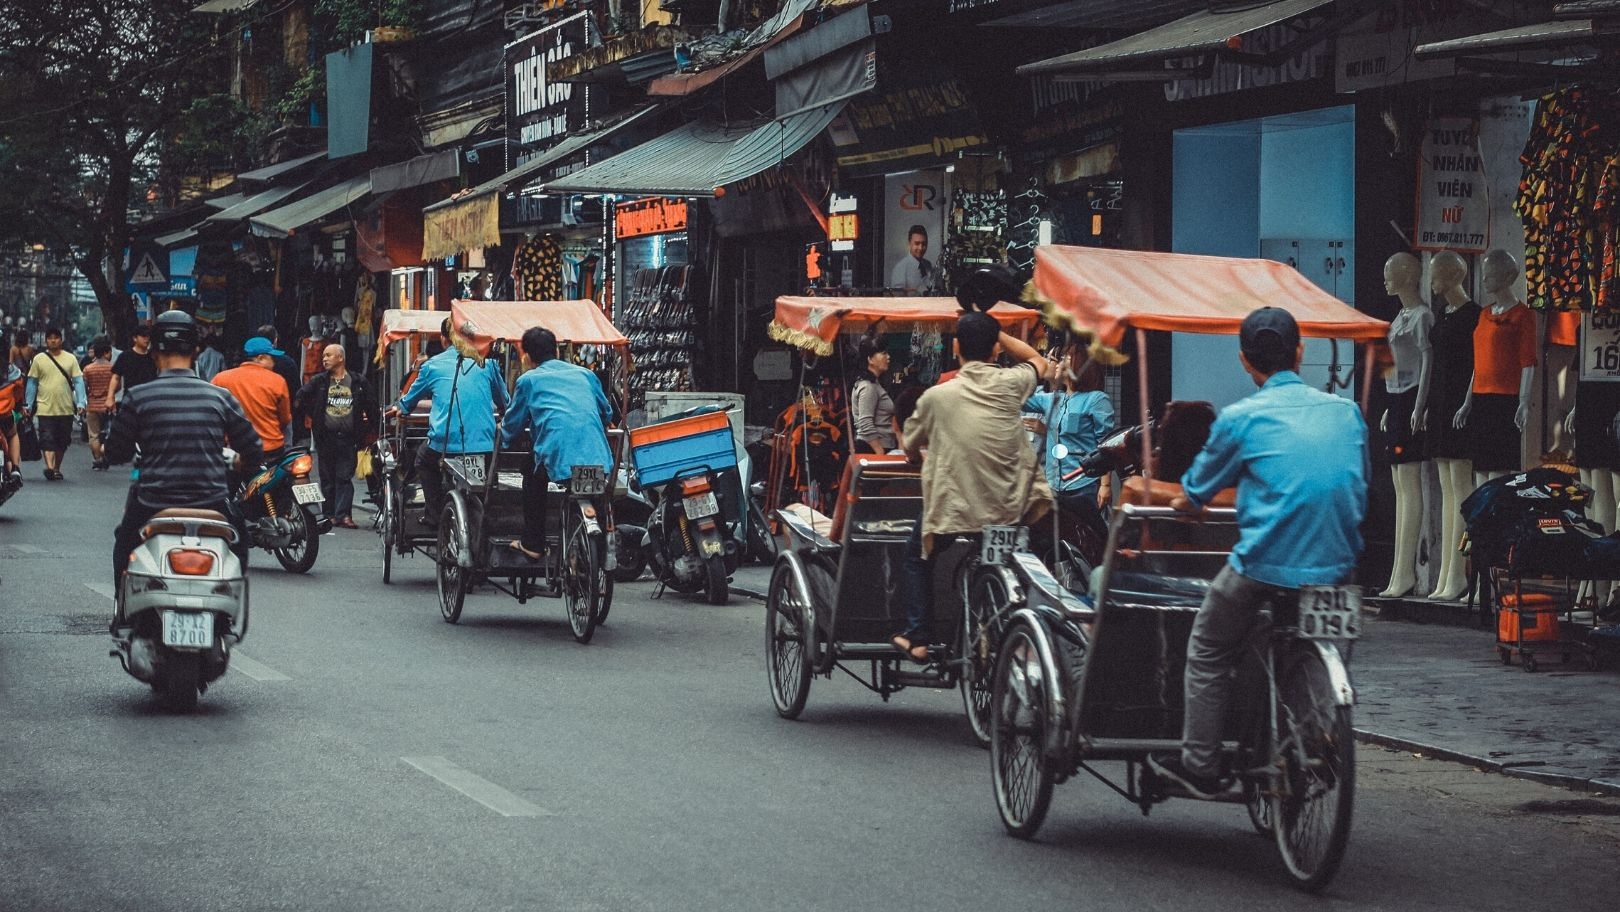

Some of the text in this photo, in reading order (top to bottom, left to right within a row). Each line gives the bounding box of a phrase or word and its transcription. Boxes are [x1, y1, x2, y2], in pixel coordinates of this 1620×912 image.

[515, 46, 545, 116] THIÊN
[1437, 178, 1472, 198] VIÊN
[1442, 203, 1465, 224] NỮ
[1305, 613, 1356, 636] 0194
[170, 630, 206, 644] 8700
